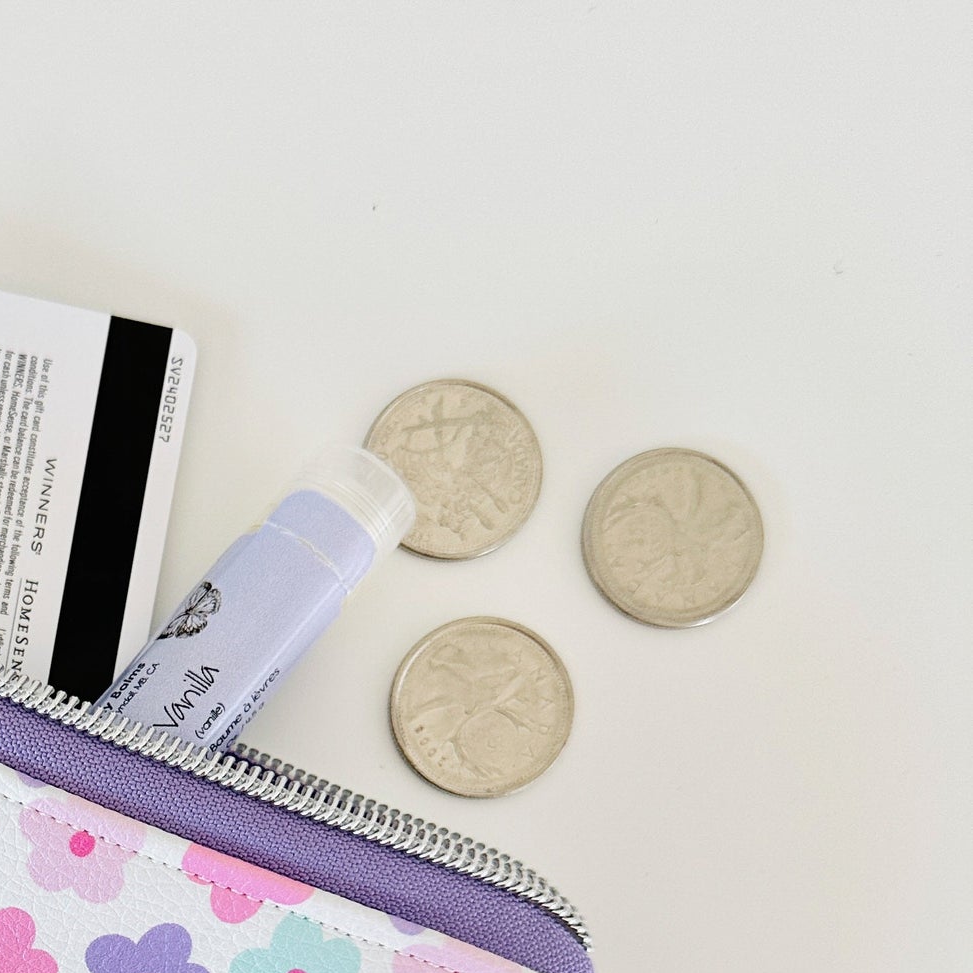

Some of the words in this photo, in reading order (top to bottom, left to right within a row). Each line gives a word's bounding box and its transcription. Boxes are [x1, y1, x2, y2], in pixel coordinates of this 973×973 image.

[110, 663, 145, 699] Balms
[146, 663, 160, 675] CA
[152, 665, 220, 728] Vanilla
[209, 714, 242, 753] Baume
[243, 703, 252, 713] à
[251, 668, 280, 703] lèvres
[195, 702, 225, 740] (vanille)
